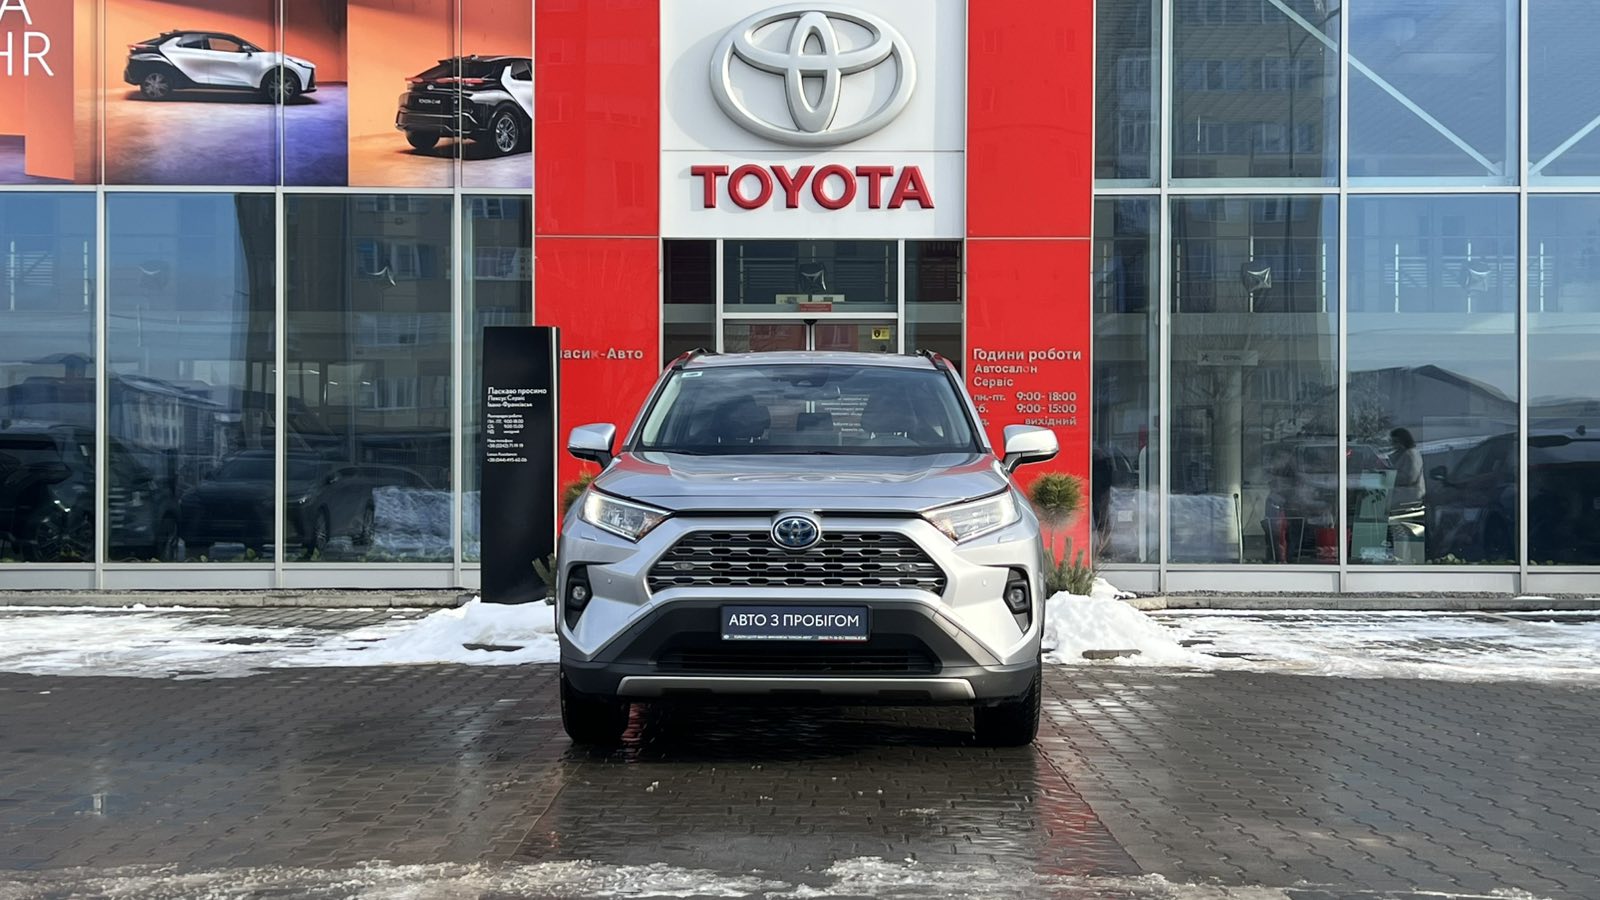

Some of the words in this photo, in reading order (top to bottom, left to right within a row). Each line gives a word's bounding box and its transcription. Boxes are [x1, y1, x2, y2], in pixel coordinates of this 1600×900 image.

[691, 164, 934, 209] TOYOTA
[560, 347, 643, 359] асик-Авто
[973, 348, 1024, 361] Години
[1029, 347, 1081, 362] роботи
[974, 364, 1037, 374] Автосалон
[973, 377, 1014, 388] Сервіс
[976, 403, 989, 413] б.
[1025, 416, 1076, 426] вихідний
[729, 614, 767, 626] АВТО
[770, 614, 779, 626] З
[783, 614, 859, 627] ПРОБІГОМ
